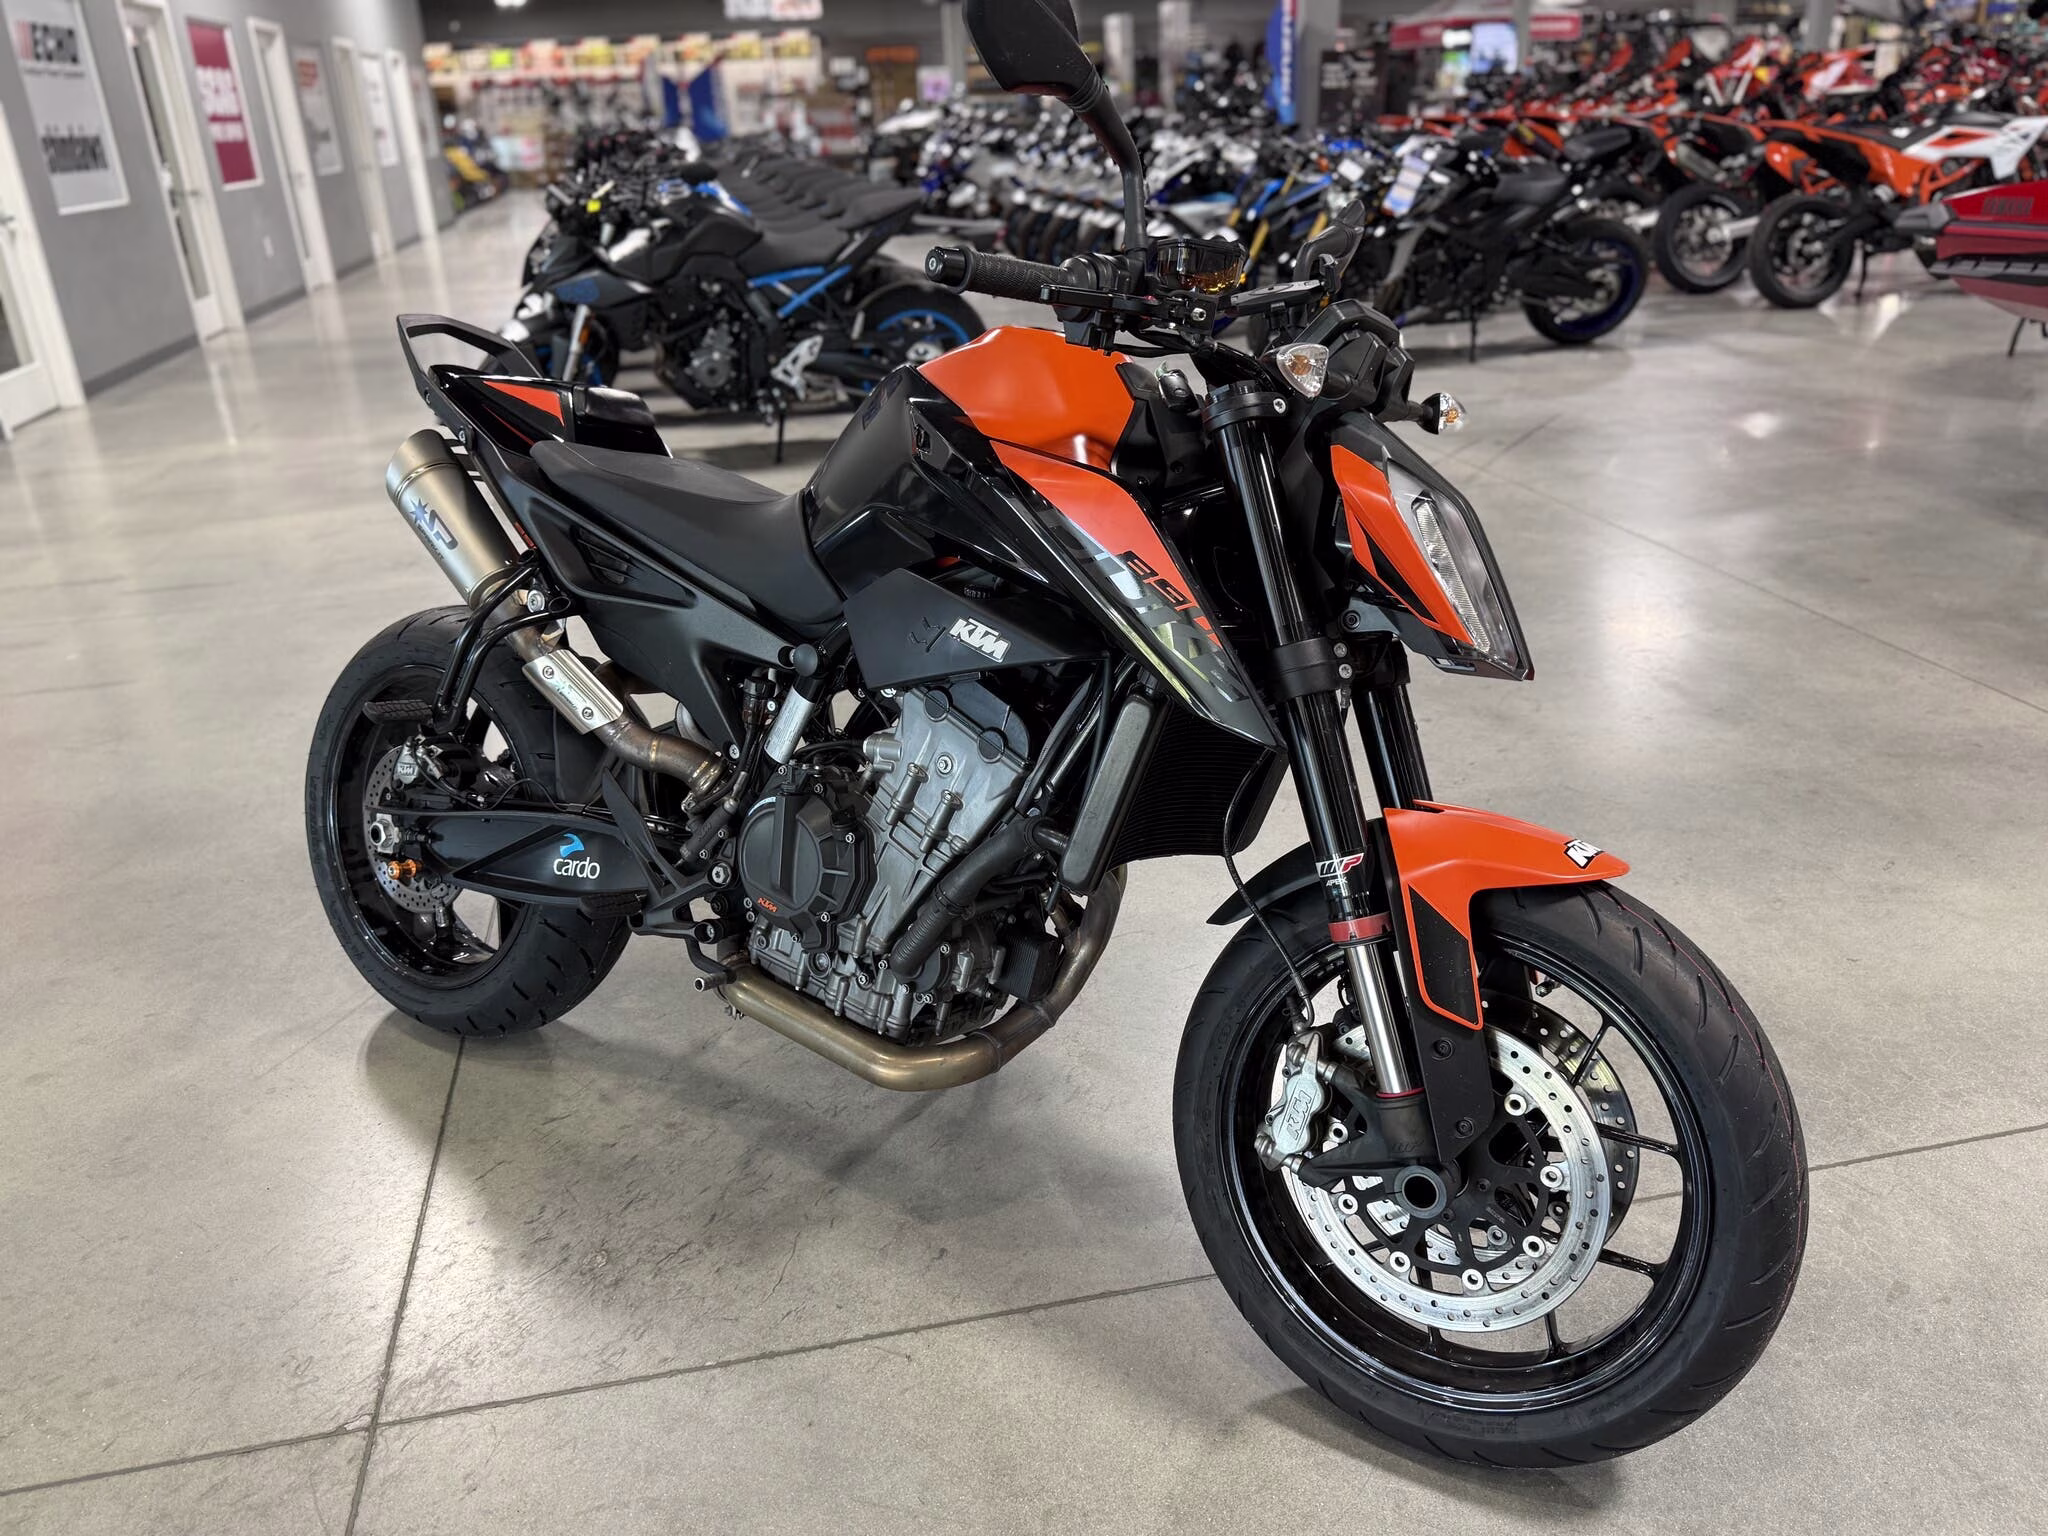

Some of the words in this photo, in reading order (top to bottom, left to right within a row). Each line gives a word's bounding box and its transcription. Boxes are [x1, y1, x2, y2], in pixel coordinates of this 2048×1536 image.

[949, 617, 1011, 662] KTM
[399, 765, 415, 776] KTM
[553, 857, 600, 879] cardo
[1326, 876, 1348, 887] APEX
[757, 897, 778, 912] KTM
[1286, 1090, 1312, 1140] KTM
